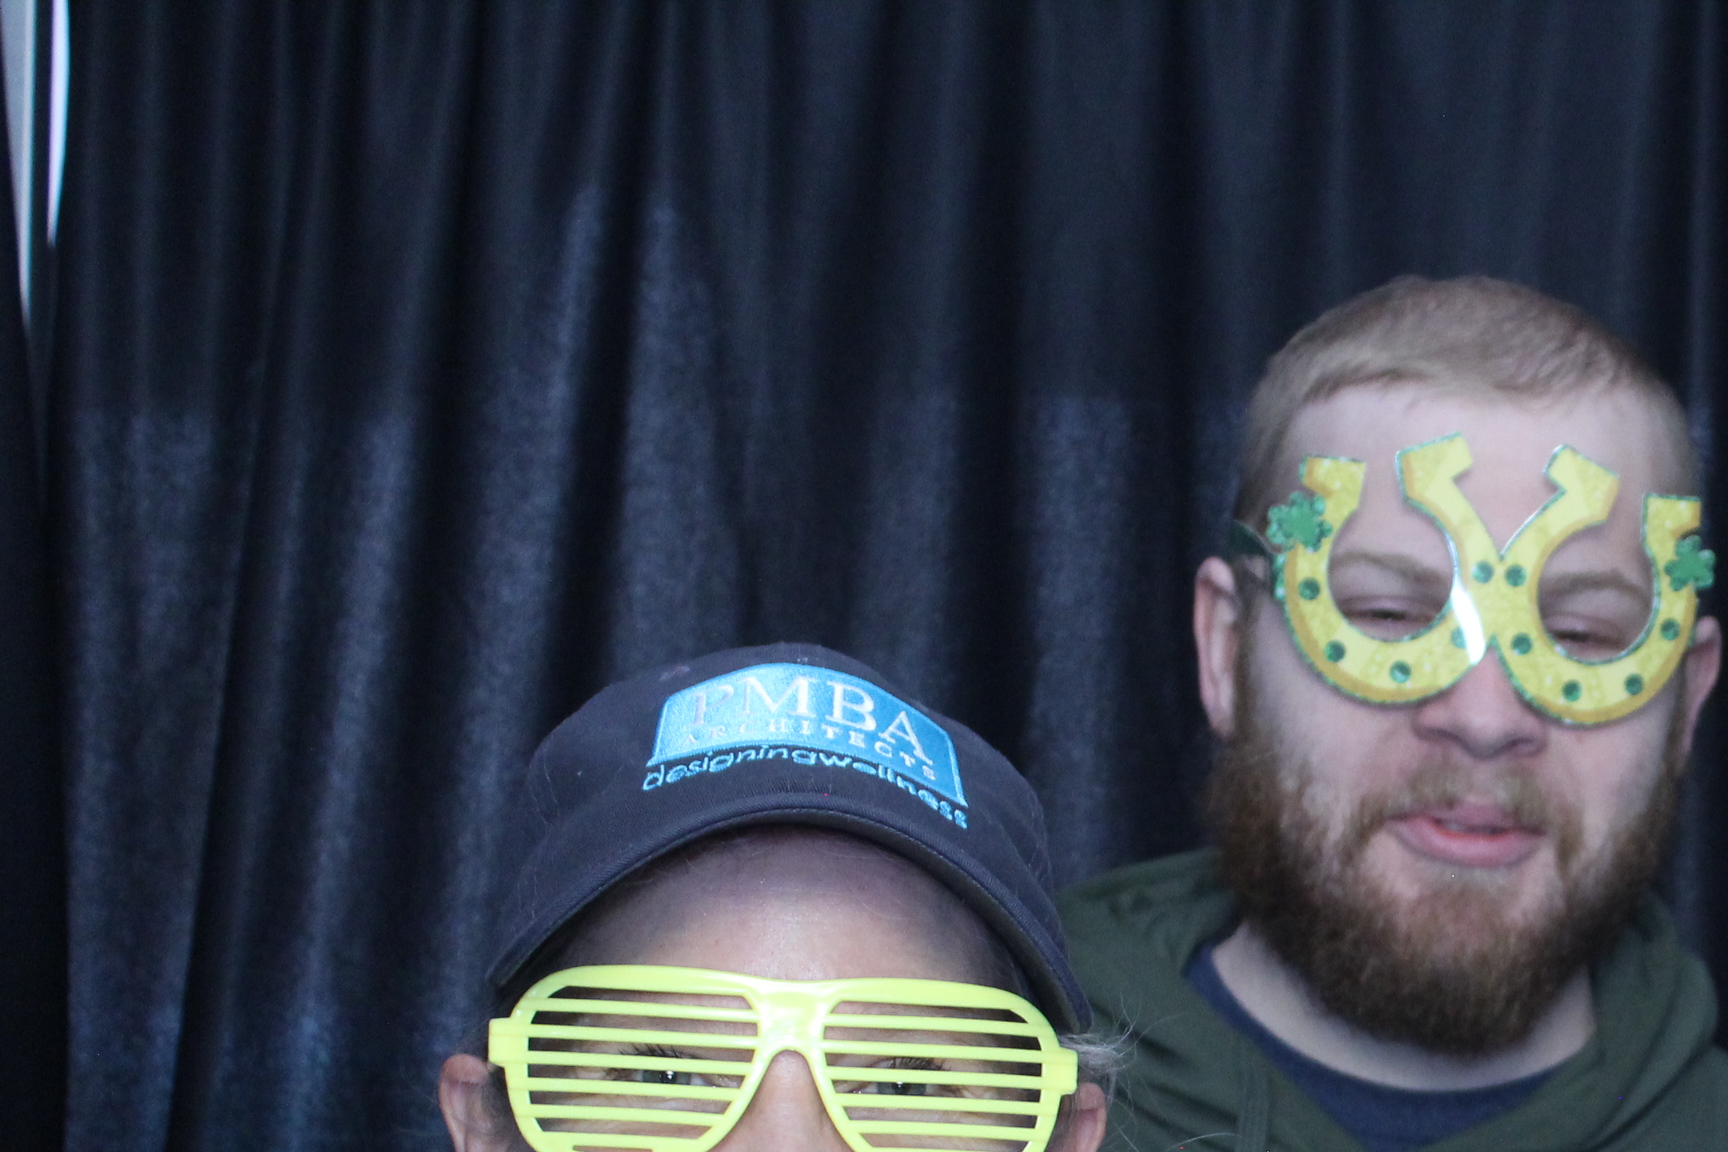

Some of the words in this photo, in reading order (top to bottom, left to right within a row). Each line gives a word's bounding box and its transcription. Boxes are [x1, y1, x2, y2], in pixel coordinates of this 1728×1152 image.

[681, 717, 937, 781] ARCHITECTS
[690, 674, 934, 765] PMBA
[641, 744, 968, 830] designingwellness
